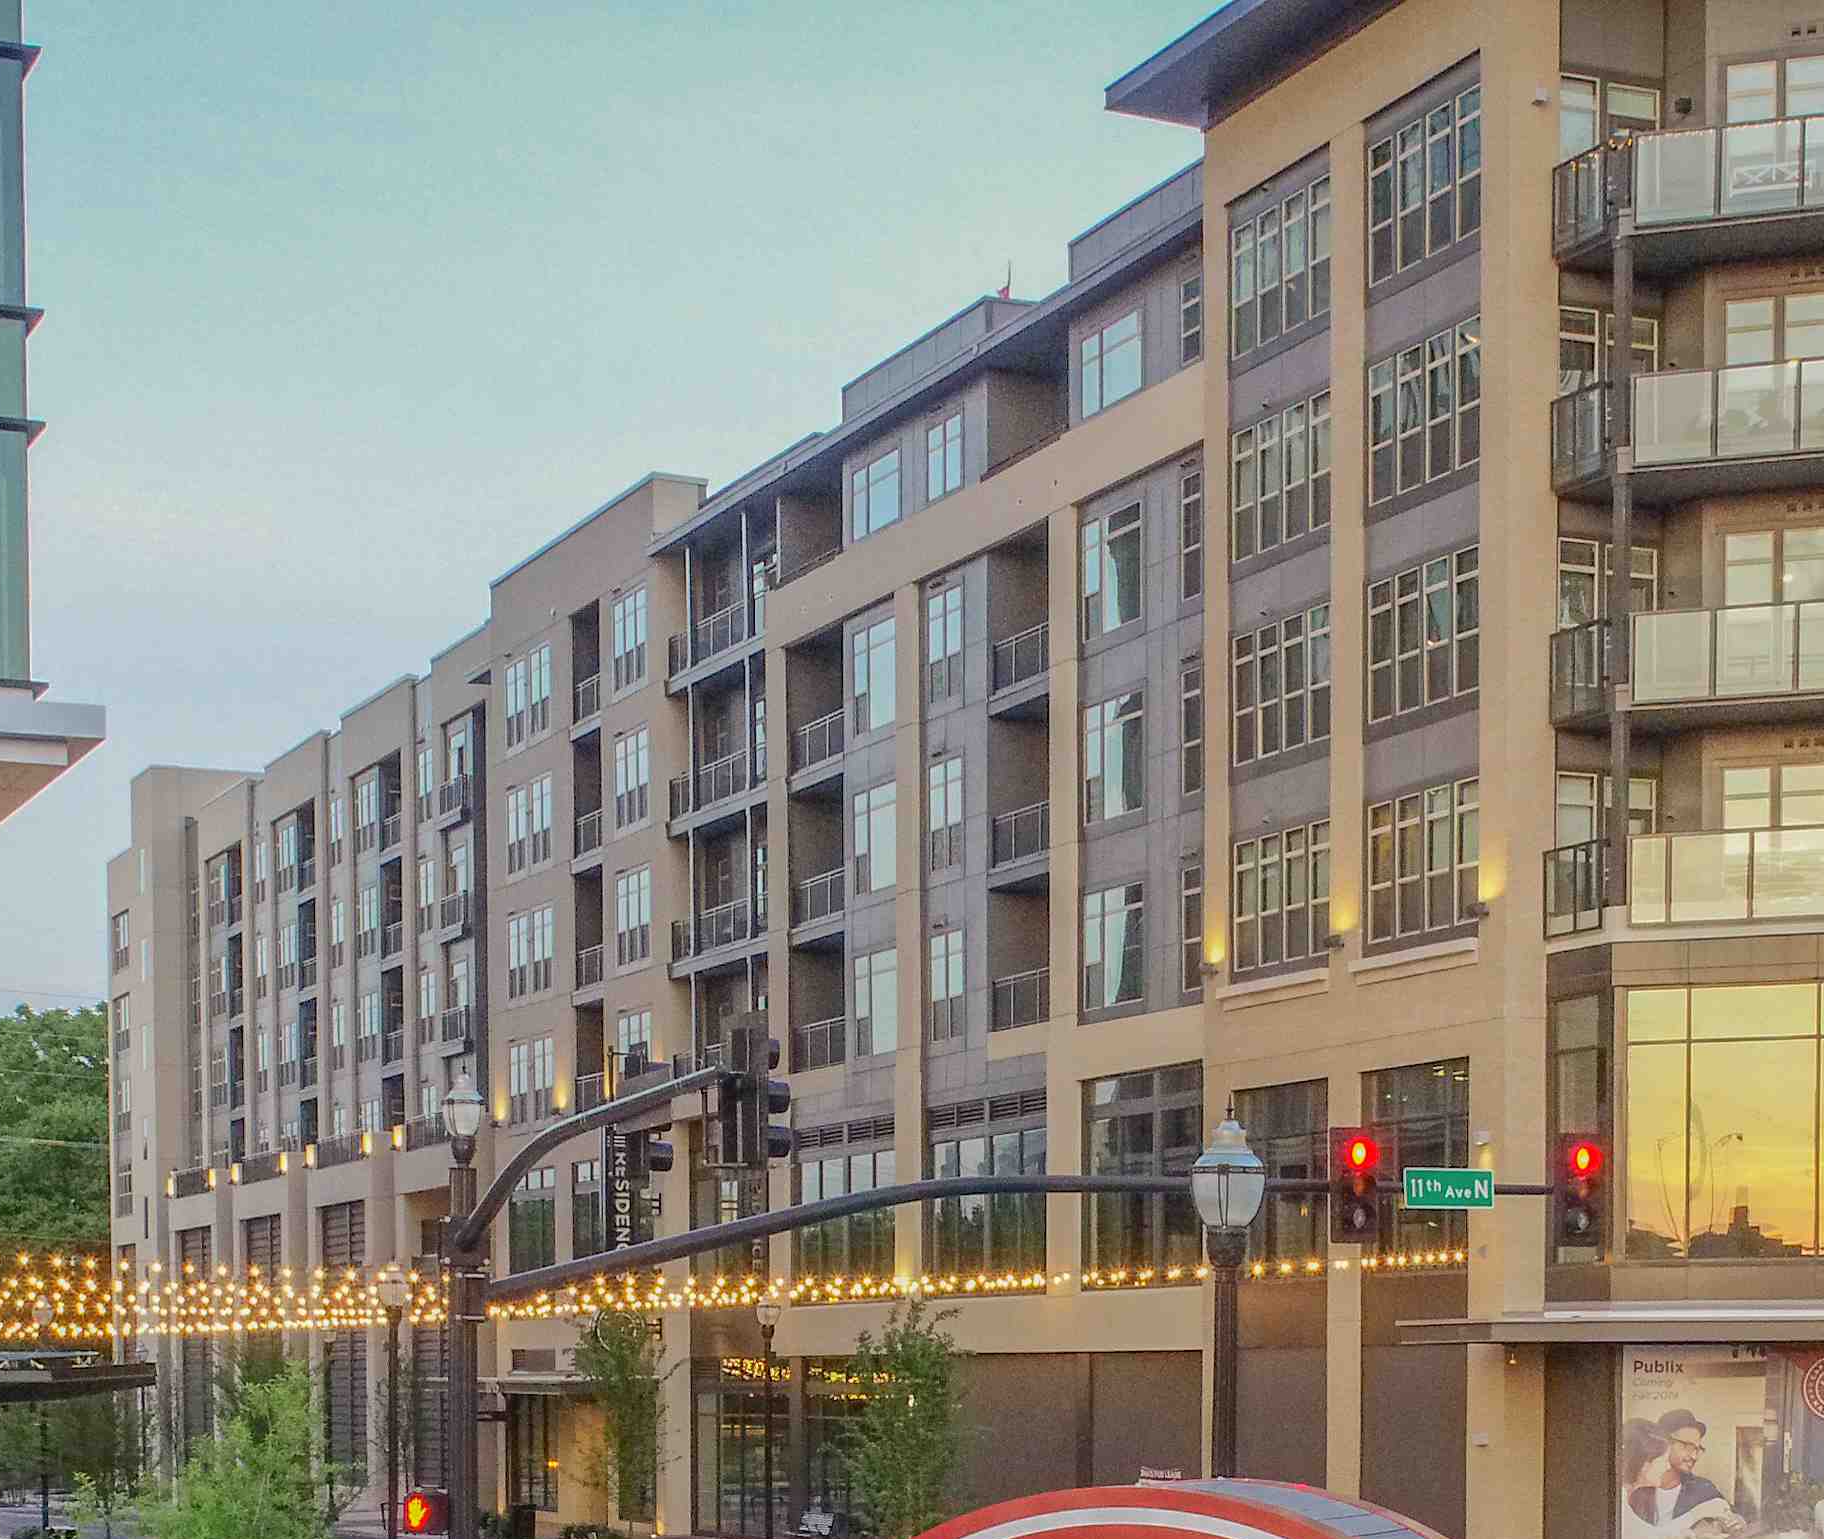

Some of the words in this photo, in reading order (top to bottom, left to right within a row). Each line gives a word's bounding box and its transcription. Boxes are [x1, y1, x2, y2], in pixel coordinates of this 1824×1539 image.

[1410, 1177, 1442, 1199] 11th
[1444, 1185, 1473, 1200] Ave
[1474, 1178, 1490, 1200] N
[1632, 1360, 1685, 1374] Publix
